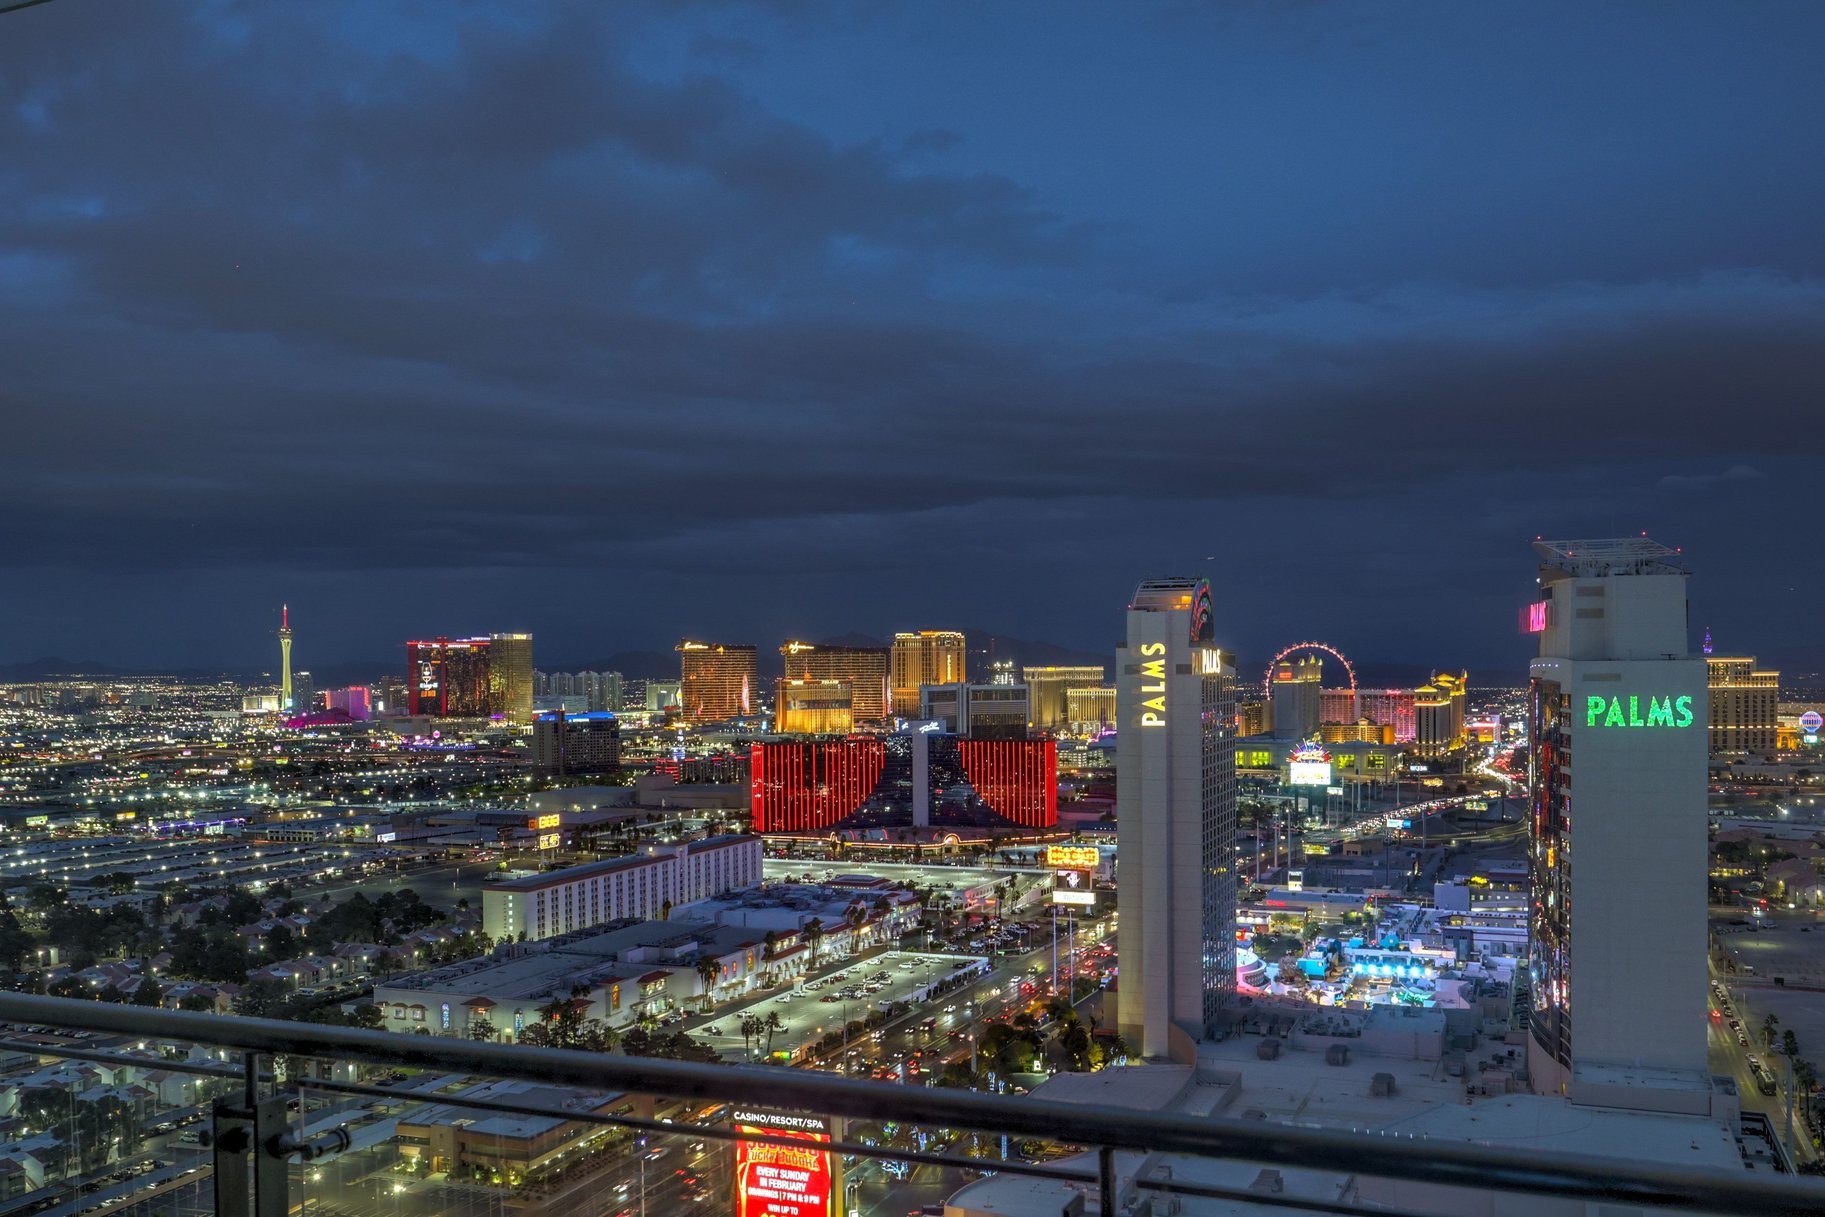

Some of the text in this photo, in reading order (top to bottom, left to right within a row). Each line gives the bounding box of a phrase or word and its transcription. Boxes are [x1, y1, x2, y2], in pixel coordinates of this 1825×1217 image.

[1202, 648, 1221, 674] PALMS
[1141, 642, 1166, 727] PALMS
[1587, 695, 1693, 728] PALMS
[733, 1111, 824, 1129] CASINO/RESORT/SPA
[756, 1166, 810, 1182] EVERY SUNDAY
[760, 1176, 807, 1192] IN FEBRUARY
[782, 1191, 787, 1200] 7
[787, 1192, 798, 1202] PM
[809, 1195, 820, 1204] PM
[767, 1203, 780, 1213] WIN
[781, 1205, 790, 1214] UP
[790, 1206, 799, 1216] TO
